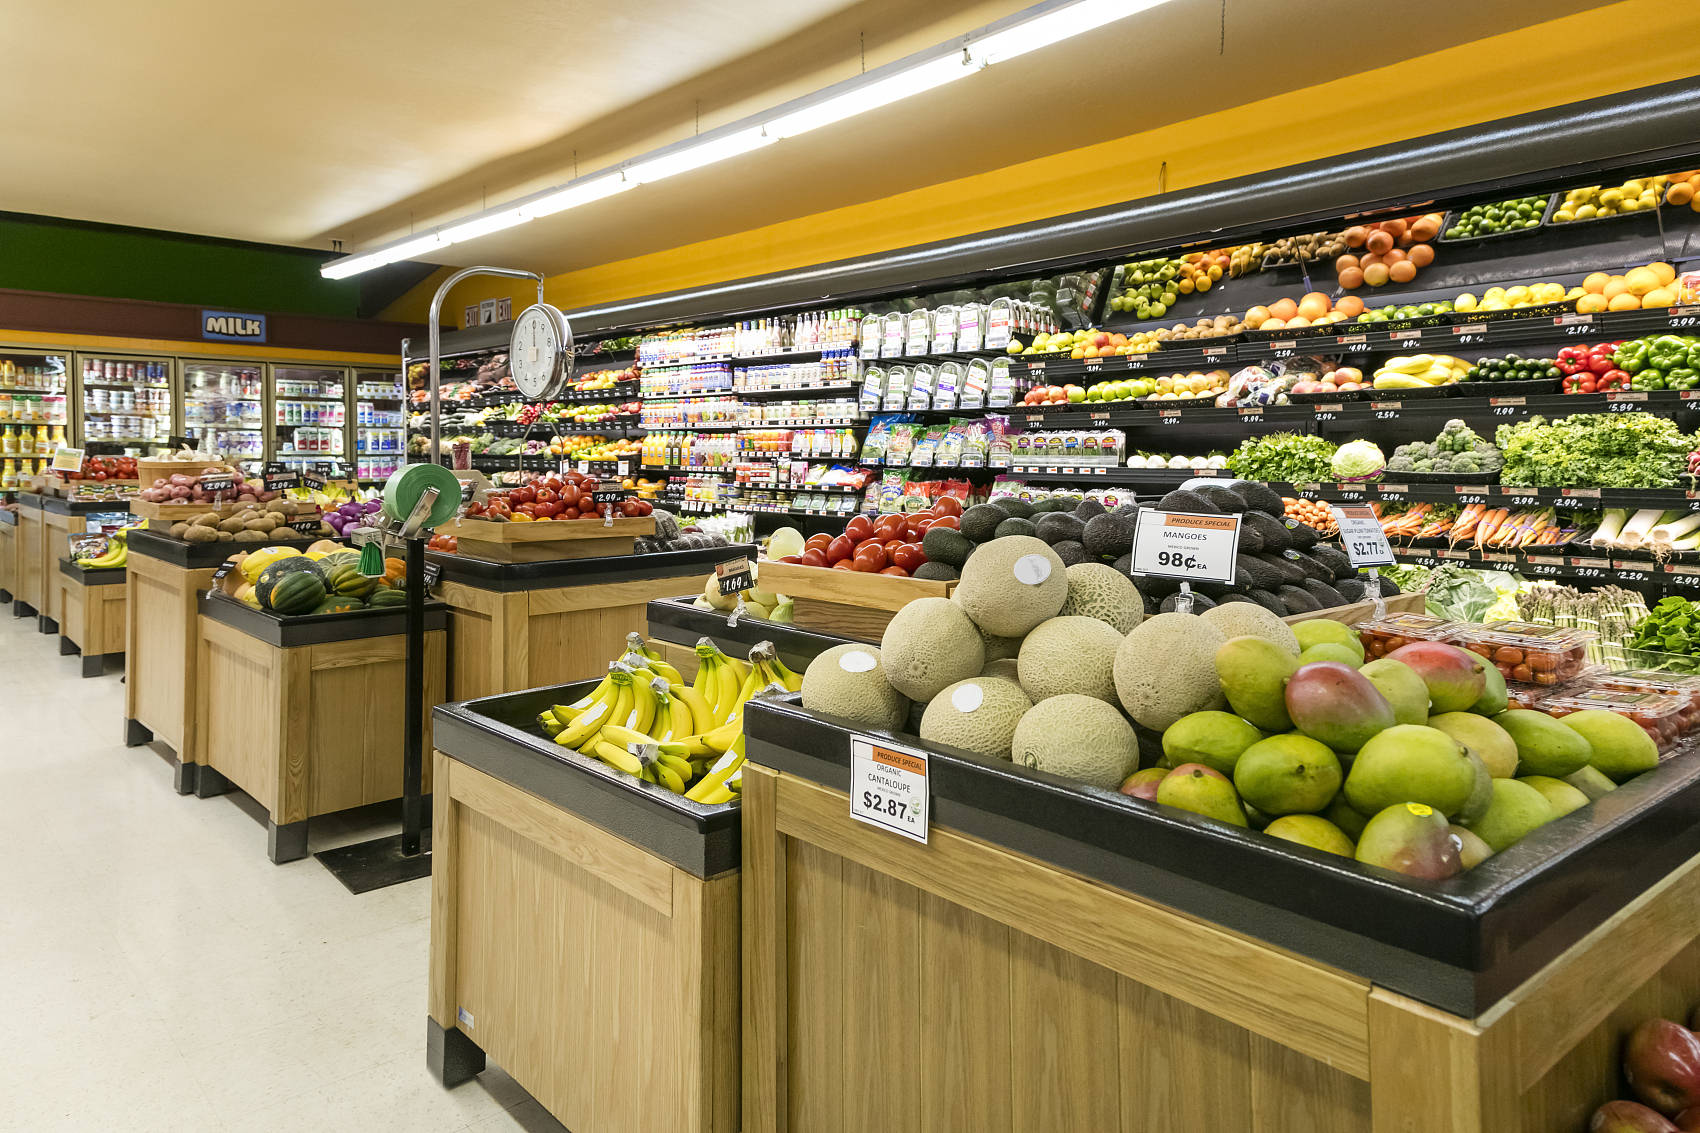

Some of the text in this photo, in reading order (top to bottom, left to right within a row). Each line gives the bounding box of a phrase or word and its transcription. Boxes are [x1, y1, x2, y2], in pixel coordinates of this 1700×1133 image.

[205, 317, 261, 335] MILK
[1171, 517, 1231, 527] PRODUCE SPECIAL
[1163, 531, 1207, 541] MANGOES
[1353, 541, 1379, 556] $2.77
[1158, 551, 1197, 571] 98¢
[877, 751, 922, 771] PRODUCE SPECIAL
[876, 764, 902, 777] ORGANIC
[868, 773, 911, 794] CANTALOUPE
[863, 791, 907, 819] $2.87
